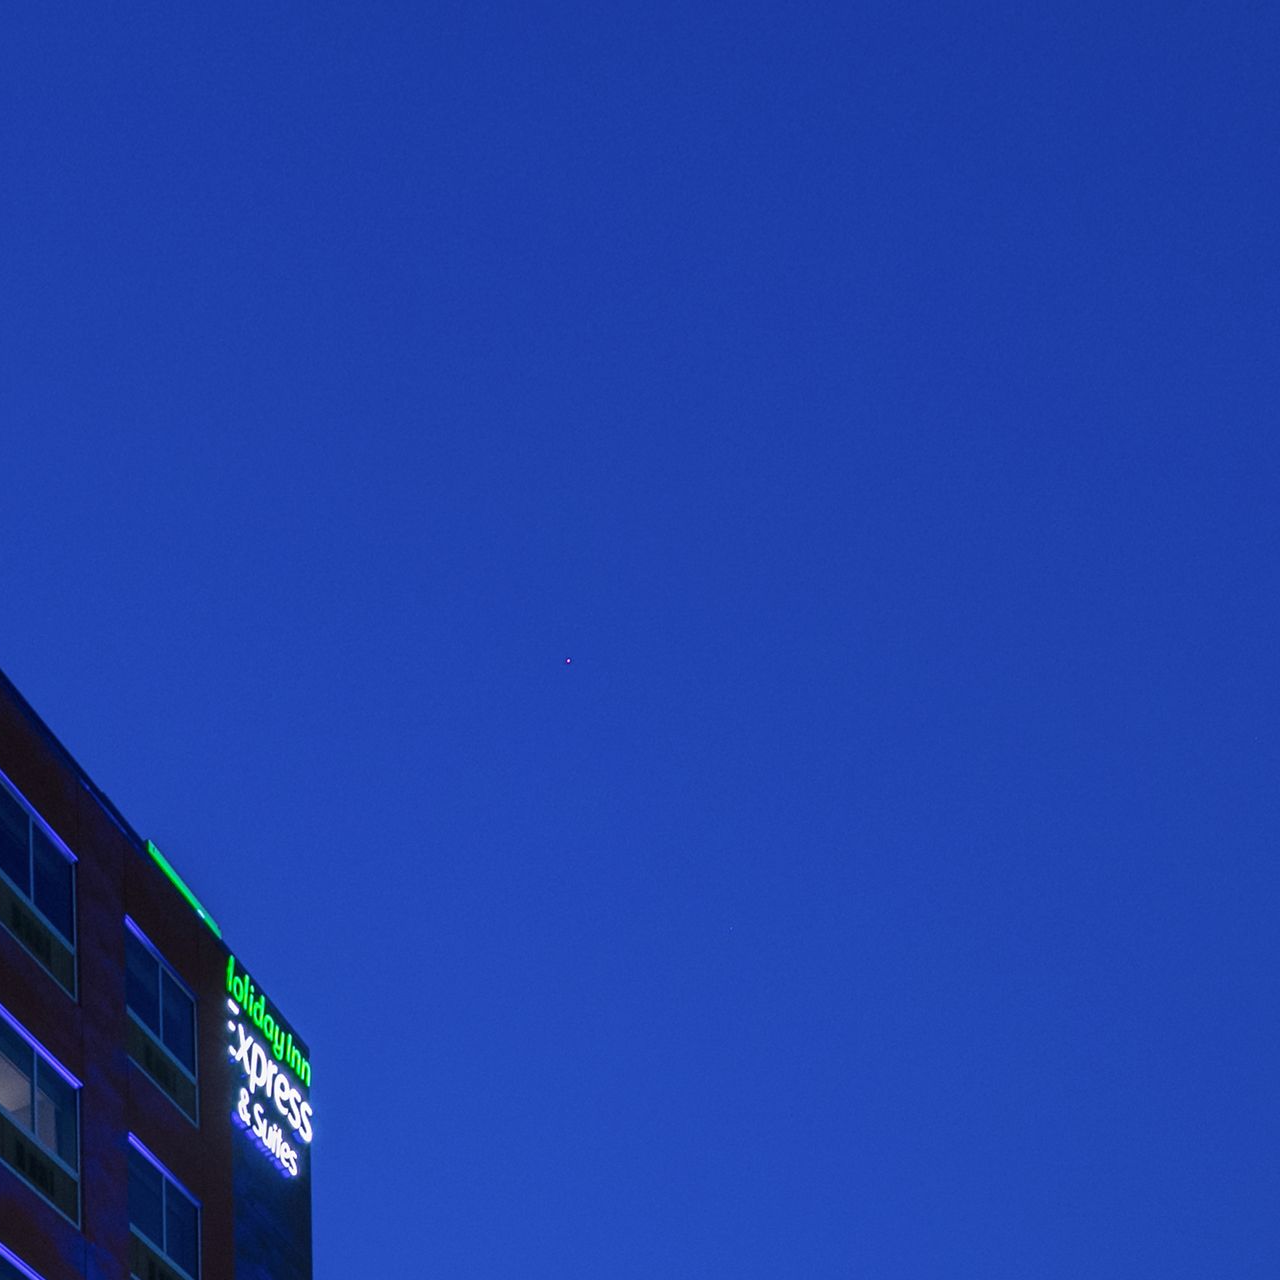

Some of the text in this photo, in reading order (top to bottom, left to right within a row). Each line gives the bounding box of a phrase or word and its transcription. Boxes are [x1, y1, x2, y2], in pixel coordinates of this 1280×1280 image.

[286, 1033, 311, 1087] Inn
[238, 1087, 298, 1176] & Suites
